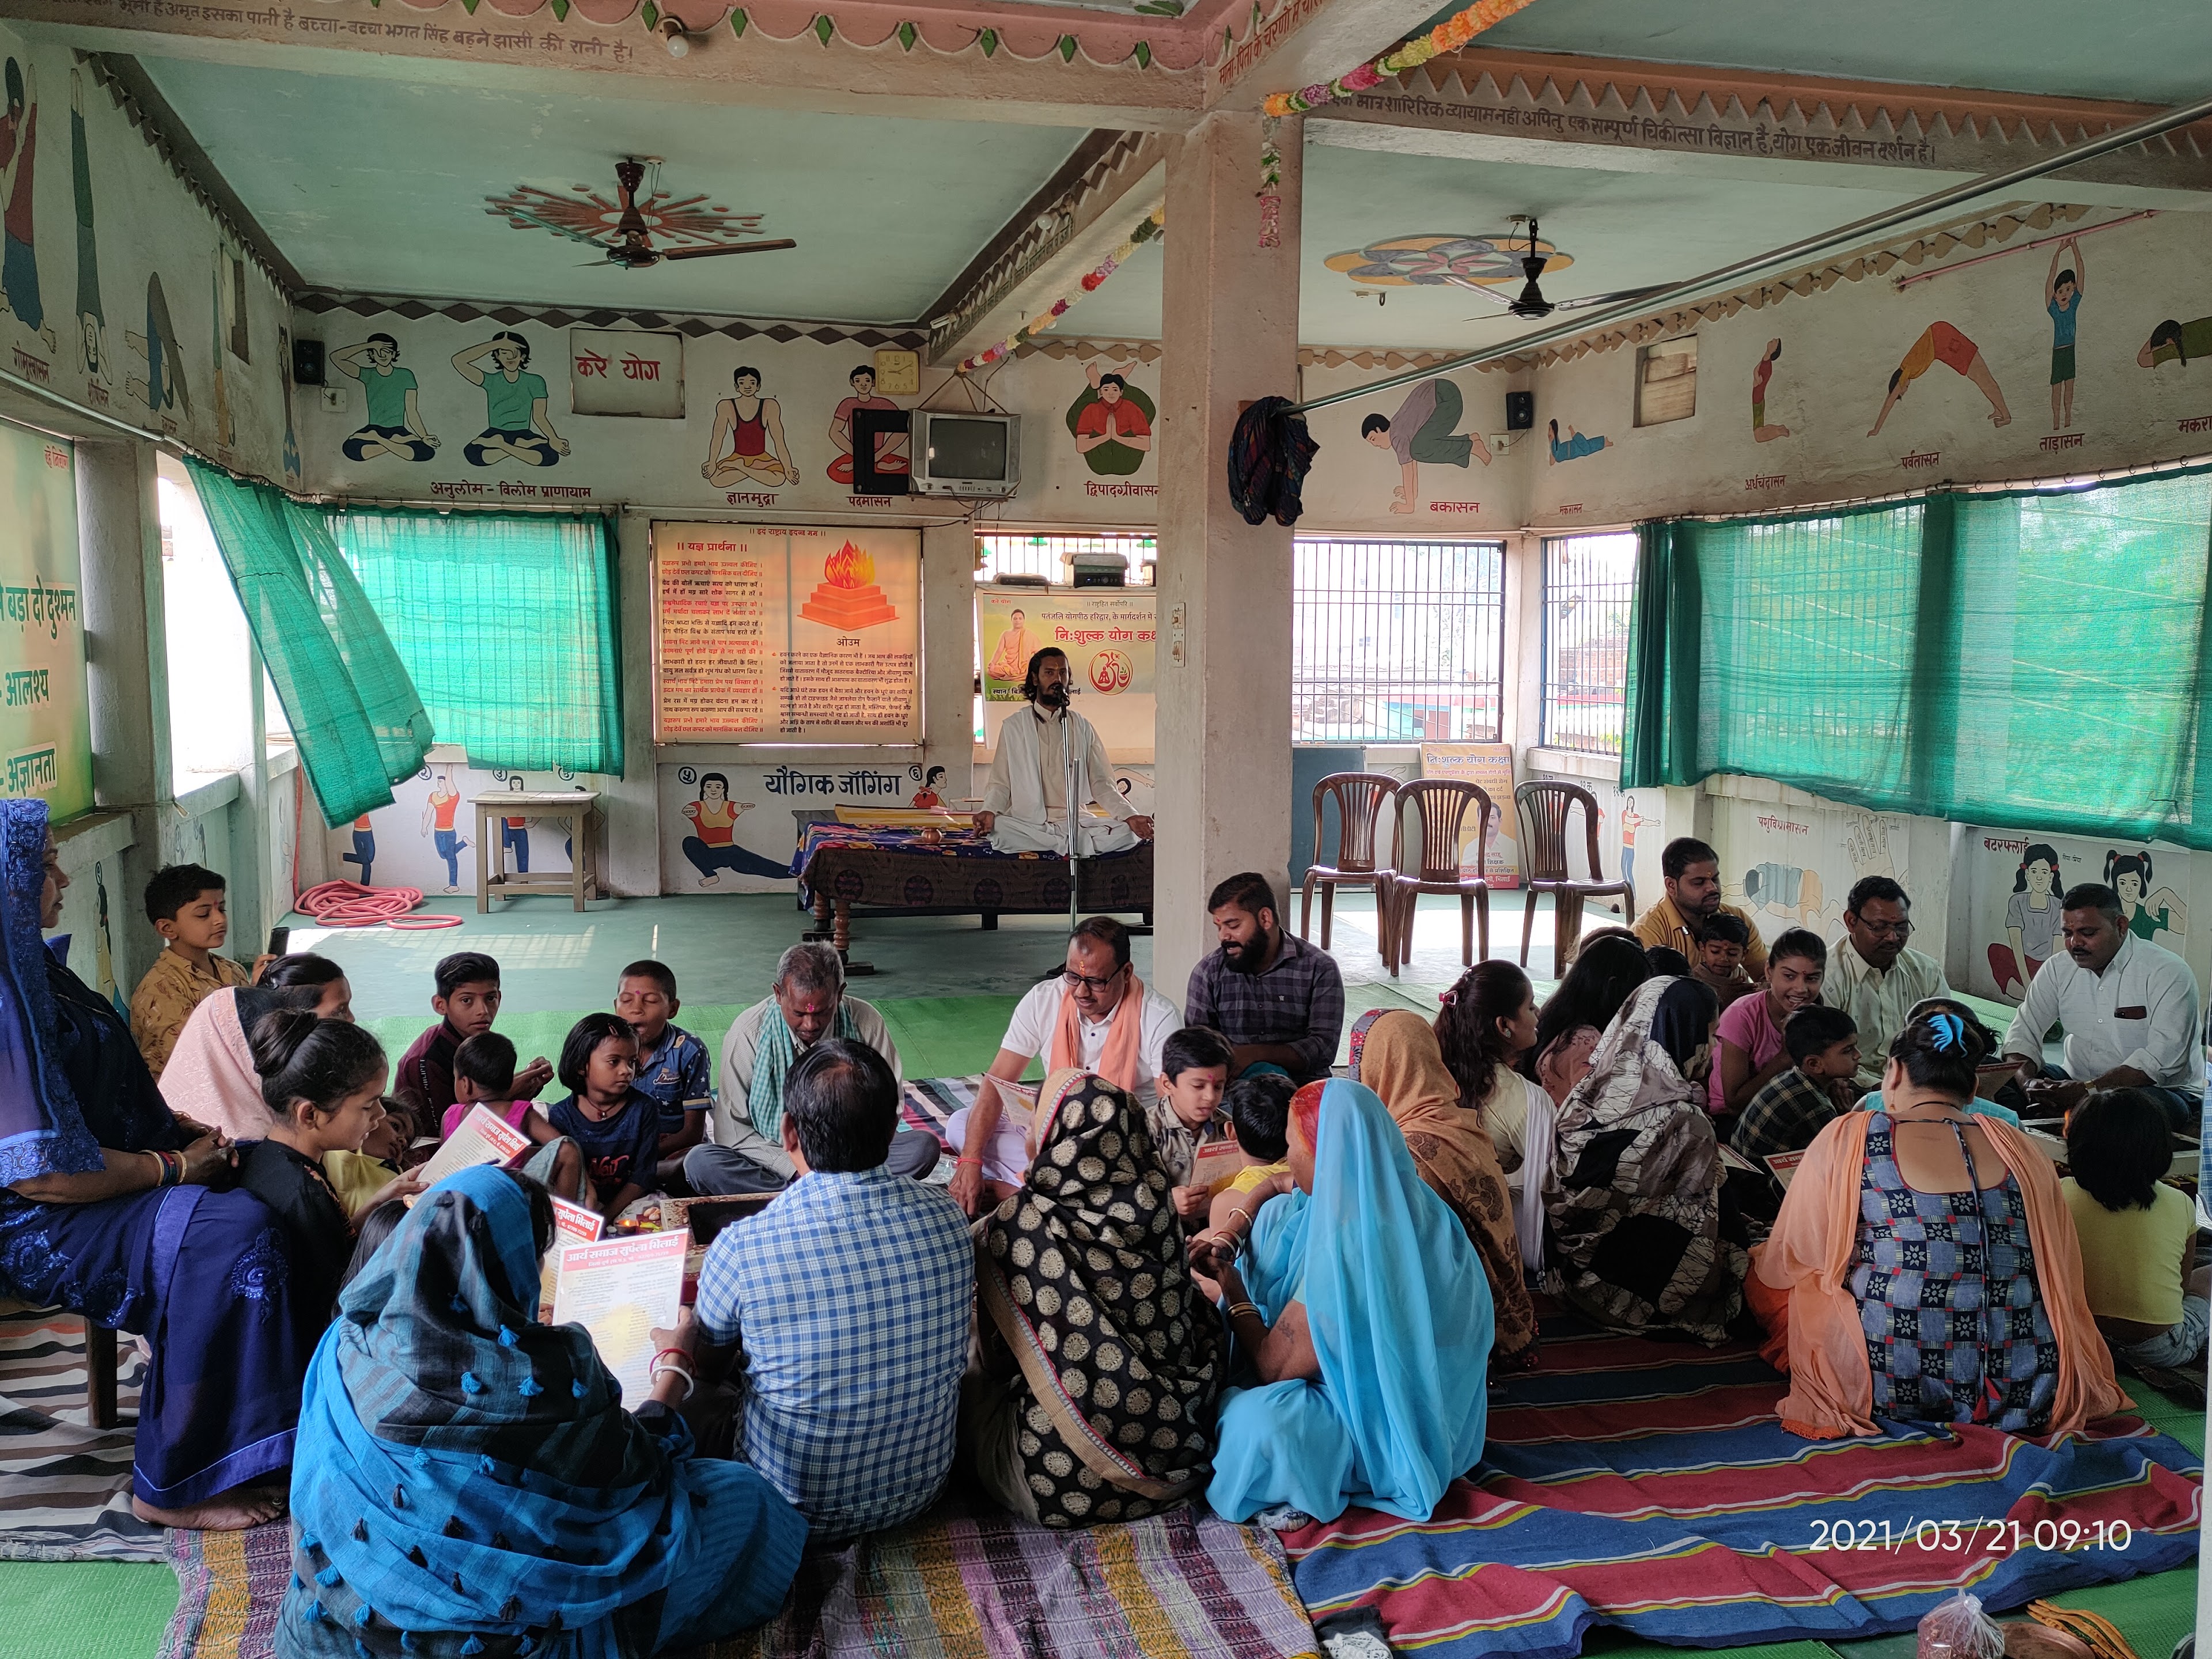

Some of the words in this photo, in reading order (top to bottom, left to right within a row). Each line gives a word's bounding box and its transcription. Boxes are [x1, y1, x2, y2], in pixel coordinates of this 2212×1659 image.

[247, 7, 281, 26] पानी
[283, 7, 295, 31] है
[385, 23, 421, 39] भगत
[423, 22, 450, 43] सिंह
[539, 32, 565, 52] की
[570, 37, 610, 56] रानी
[1253, 33, 1262, 58] के
[1445, 102, 1497, 123] व्यायाम
[1522, 107, 1565, 133] अपितु
[1567, 115, 1590, 132] एक
[1707, 123, 1754, 150] विज्ञान
[1804, 136, 1831, 156] एक
[1831, 133, 1877, 158] जीवन
[575, 348, 607, 378] करे
[619, 351, 661, 381] योग
[2039, 433, 2085, 454] ताड़ासन
[1900, 450, 1941, 469] पर्वतासन
[430, 479, 491, 498] अनुलोम
[496, 480, 537, 497] विलोम
[540, 486, 592, 498] प्राणायाम
[1430, 501, 1480, 514] बकासन
[688, 543, 704, 551] यज्ञ
[707, 540, 737, 552] प्रार्थना
[5, 587, 29, 632] बड़ा
[30, 575, 45, 627] दो
[45, 589, 76, 640] दुश्मन
[1041, 612, 1064, 620] पतंजलि
[1065, 612, 1088, 620] योगपीठ
[1120, 613, 1146, 621] मार्गदर्शन
[1108, 626, 1133, 642] योग
[1466, 754, 1486, 764] योग
[1488, 756, 1510, 765] कक्षा
[7, 748, 56, 797] अज्ञानता
[763, 766, 834, 796] यौगिक
[838, 770, 903, 796] जॉगिंग
[575, 1214, 596, 1232] भिलाई
[566, 1249, 589, 1262] आर्य
[590, 1248, 618, 1259] समाज
[619, 1243, 647, 1257] सुपेला
[649, 1236, 679, 1250] भिलाई
